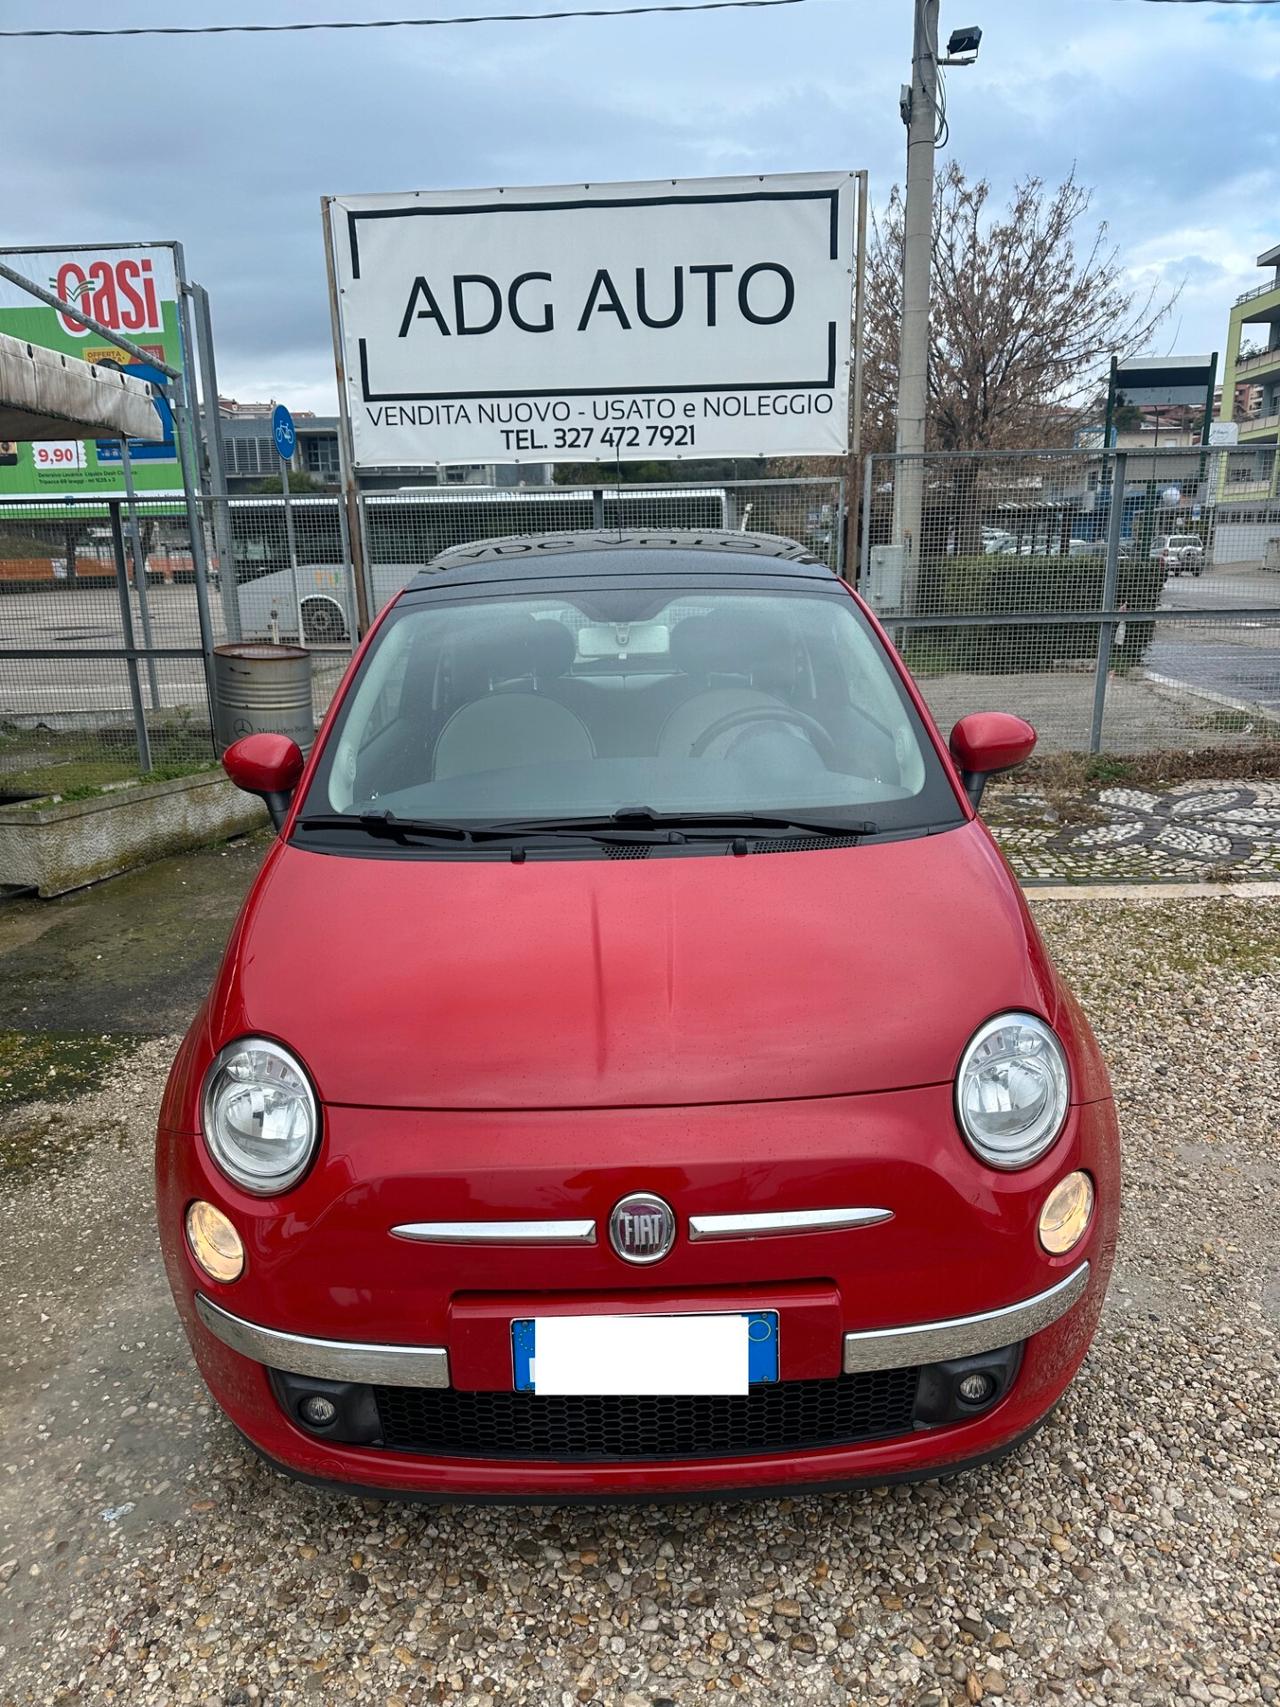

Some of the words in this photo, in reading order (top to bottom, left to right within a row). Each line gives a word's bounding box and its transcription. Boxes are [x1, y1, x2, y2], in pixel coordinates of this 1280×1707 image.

[398, 271, 554, 337] ADG
[577, 261, 795, 331] AUTO
[87, 350, 122, 358] OFFERTA
[366, 405, 471, 426] VENDITA
[479, 401, 571, 423] NUOVO
[593, 399, 676, 420] USATO
[683, 402, 696, 417] e
[704, 393, 833, 417] NOLEGGIO
[500, 429, 548, 450] TEL.
[553, 428, 594, 448] 327
[600, 426, 640, 447] 472
[646, 425, 695, 446] 7921
[38, 448, 73, 465] 9,90
[624, 1213, 662, 1246] FIAT
